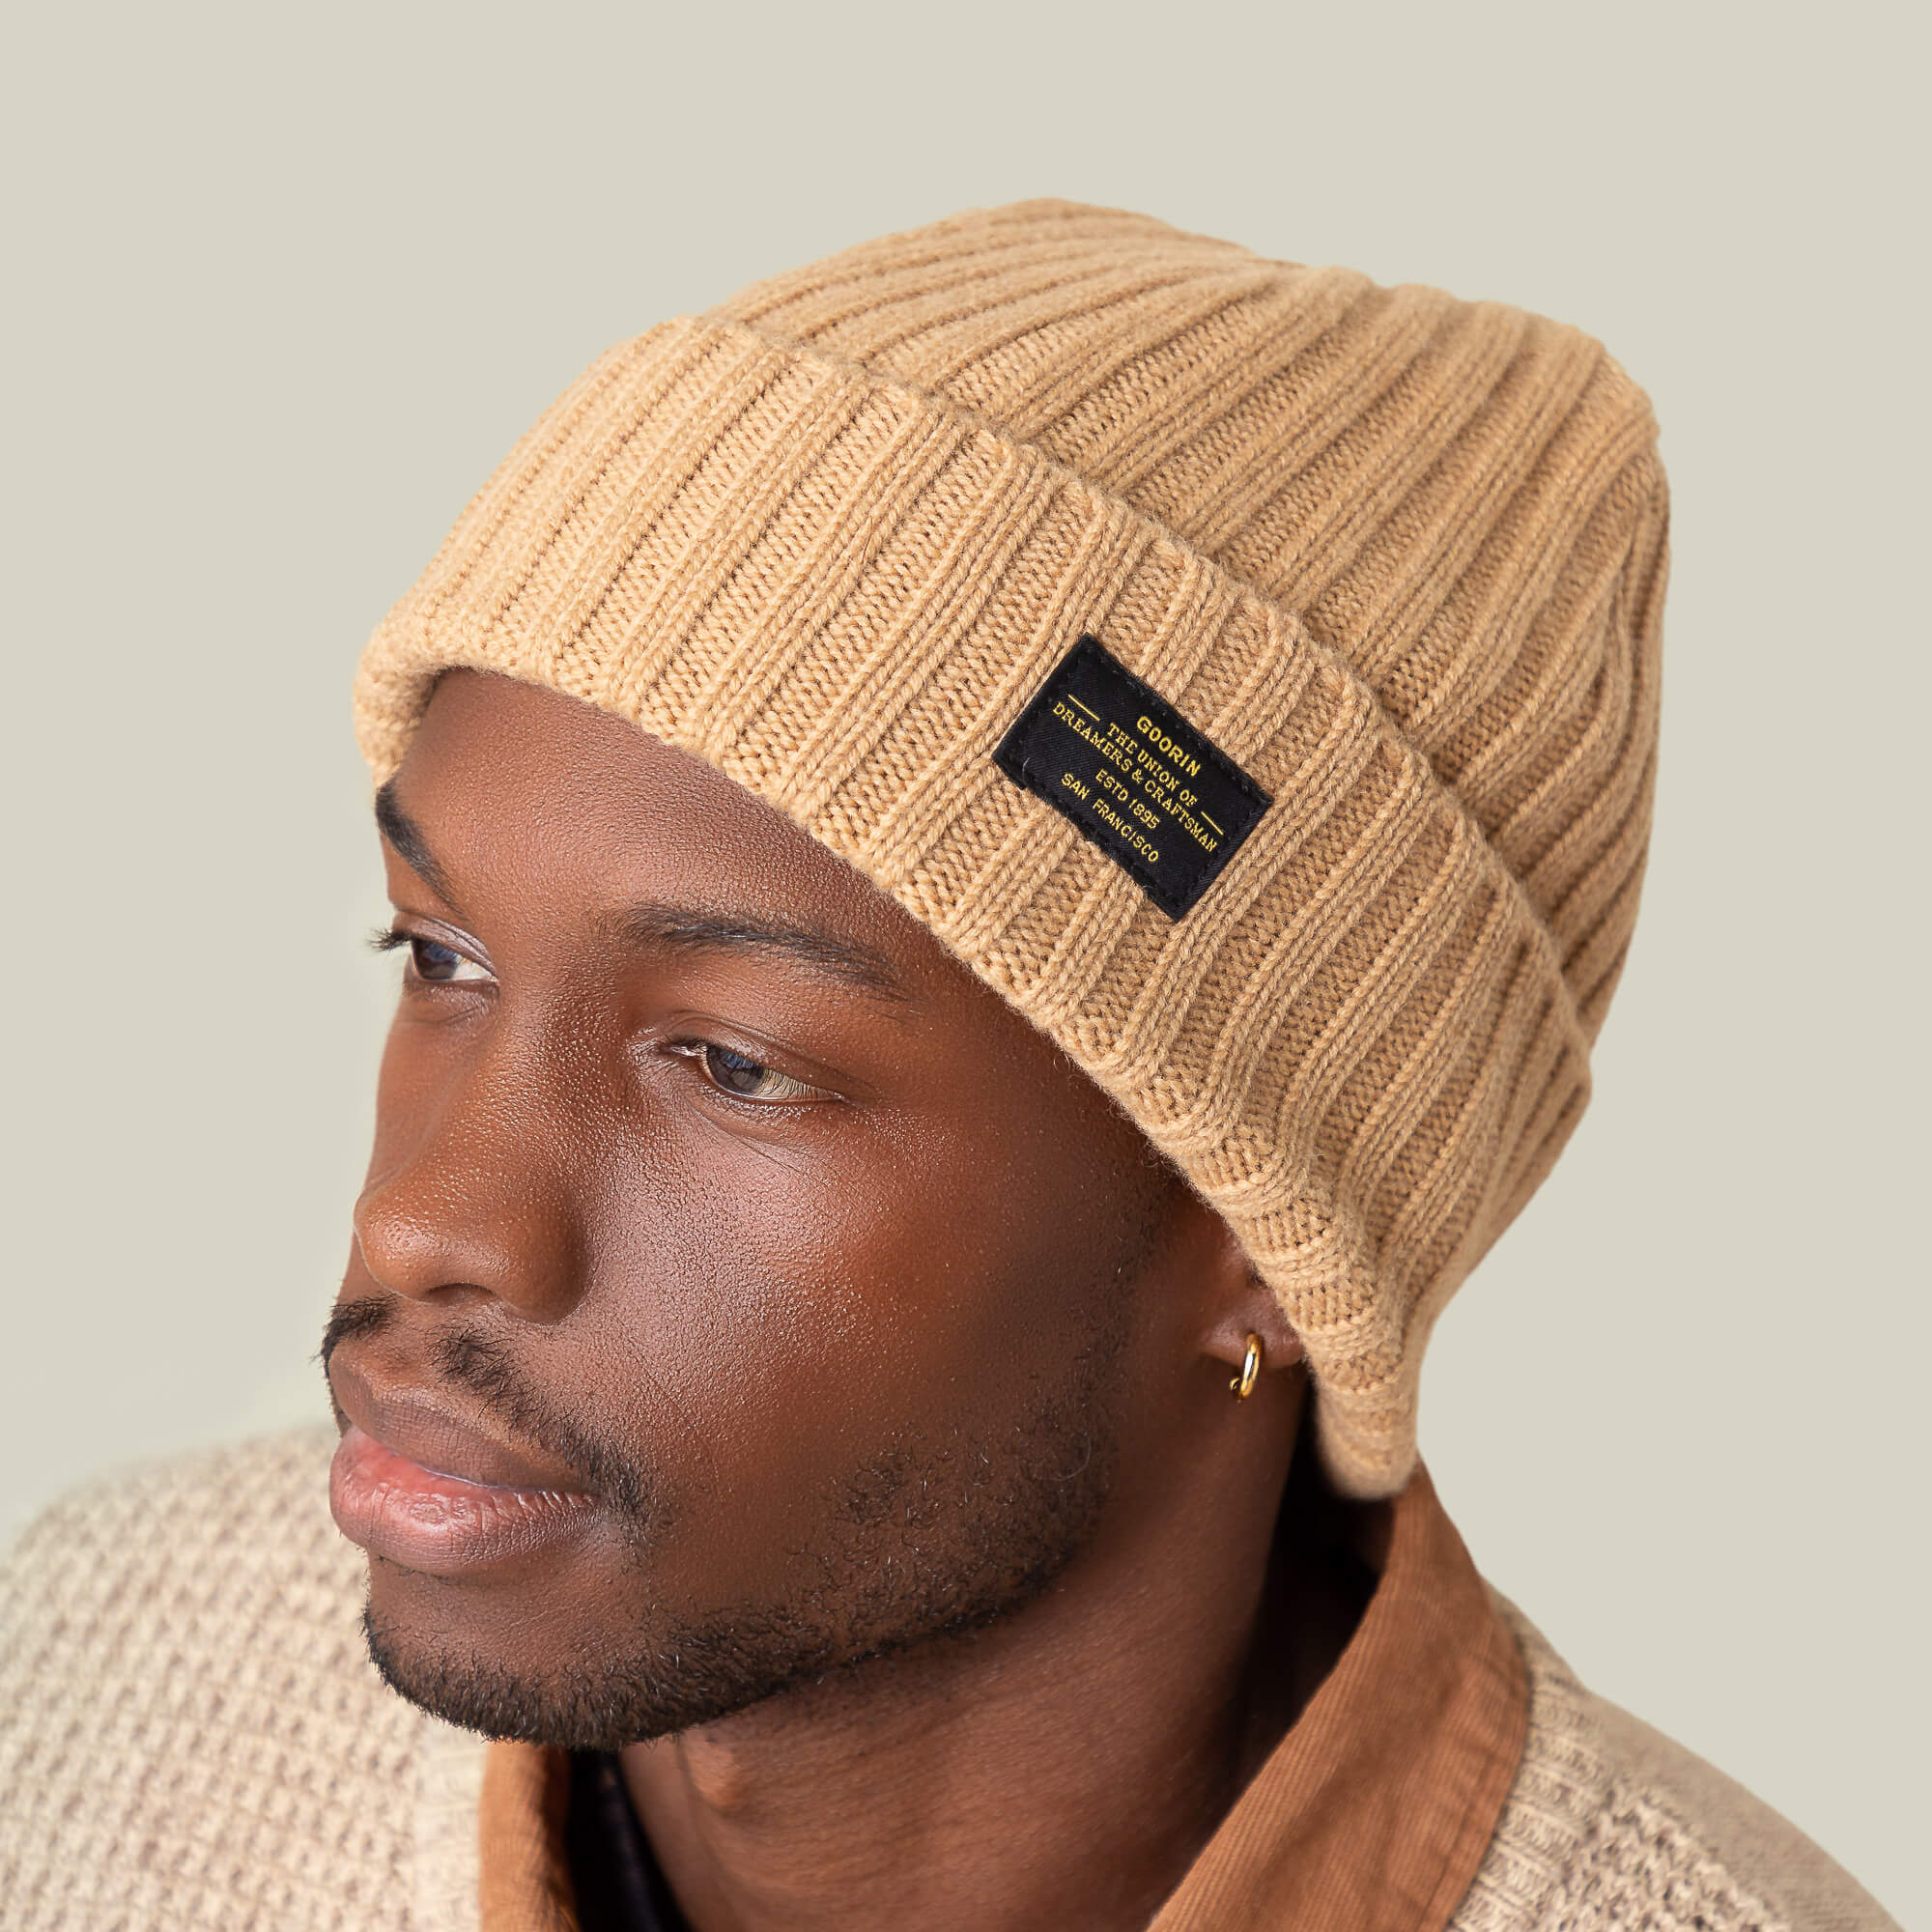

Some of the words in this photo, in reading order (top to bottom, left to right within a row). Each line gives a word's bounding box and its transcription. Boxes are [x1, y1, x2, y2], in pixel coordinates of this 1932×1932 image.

[1052, 702, 1132, 772] DREAMERS
[1132, 771, 1143, 785] &
[1145, 780, 1218, 853] CRAFTSMAN
[1107, 723, 1138, 753] THE
[1139, 749, 1180, 792] UNION
[1179, 789, 1197, 807] OF
[1136, 716, 1201, 777] GOORIN
[1061, 773, 1091, 800] SAN
[1093, 798, 1159, 863] FRANCISCO
[1095, 769, 1128, 801] ESTD
[1129, 799, 1160, 829] 1895
